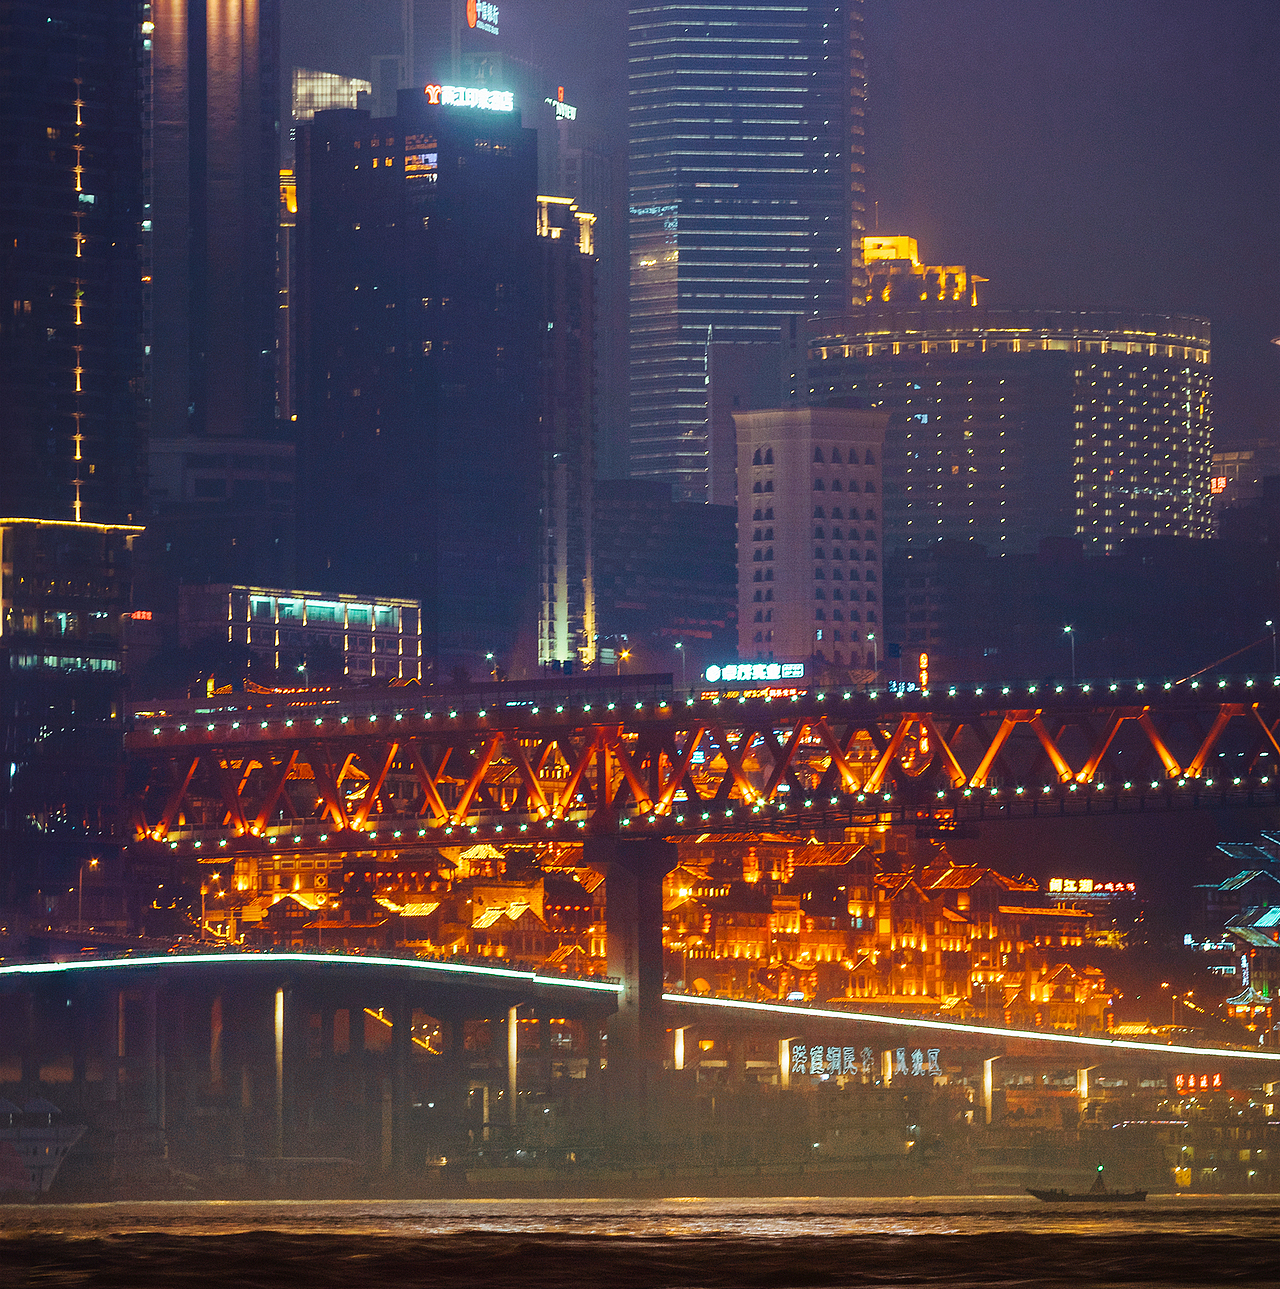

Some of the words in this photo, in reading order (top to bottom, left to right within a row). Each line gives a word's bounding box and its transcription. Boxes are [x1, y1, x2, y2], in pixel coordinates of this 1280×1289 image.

[441, 85, 514, 112] 两江印象酒店
